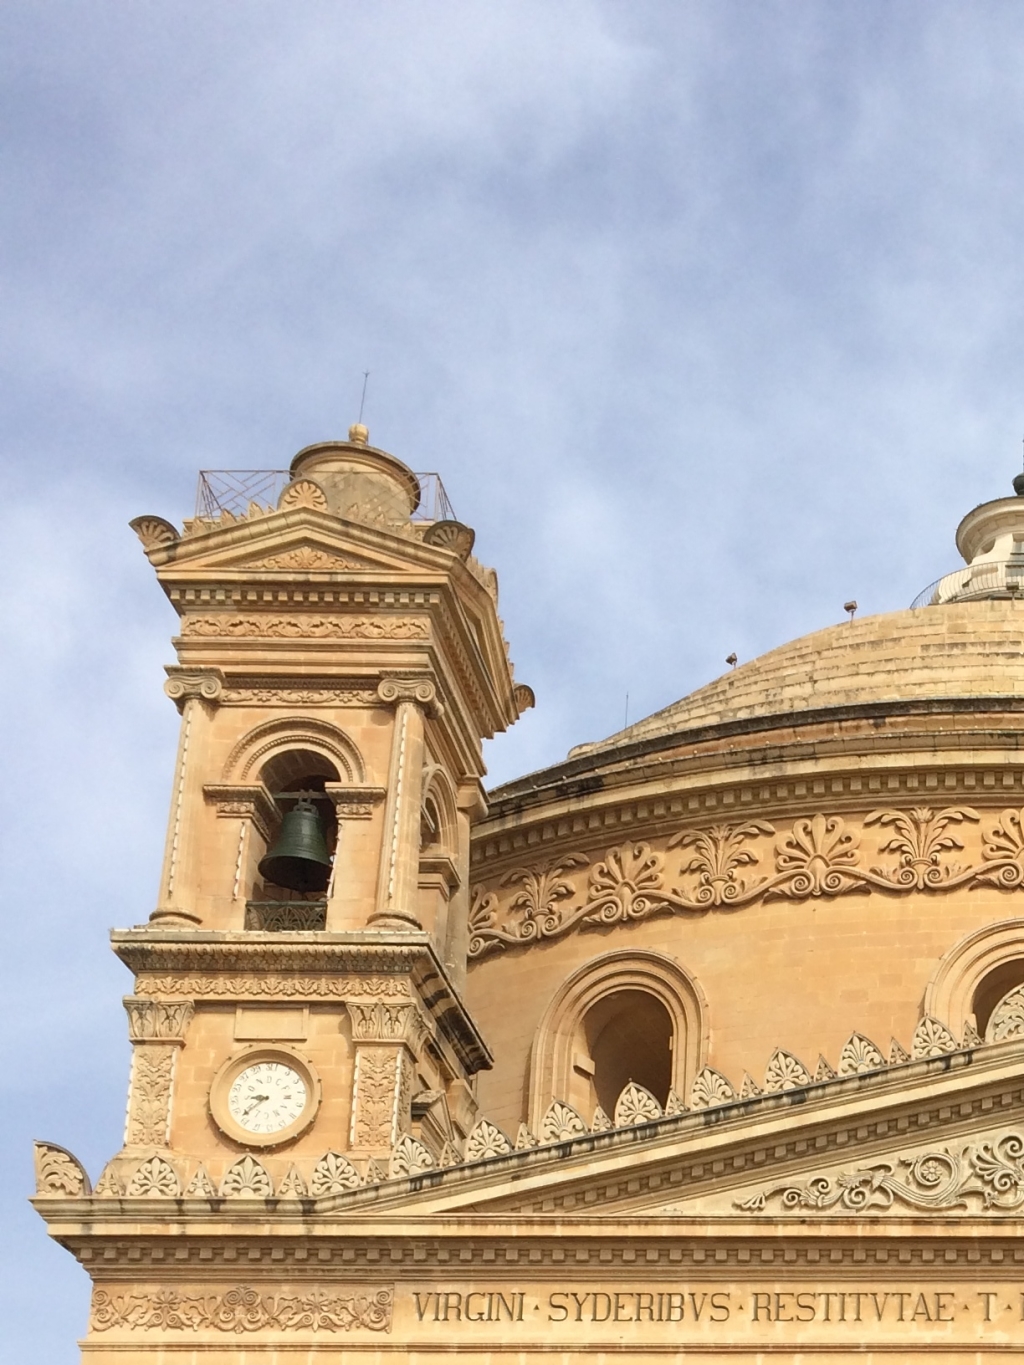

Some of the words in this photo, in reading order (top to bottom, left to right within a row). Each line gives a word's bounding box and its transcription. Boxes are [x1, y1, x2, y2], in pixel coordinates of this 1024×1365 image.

[411, 1292, 526, 1323] VIRGINI
[547, 1292, 731, 1323] SYDERIBVS
[751, 1292, 955, 1323] RESTITVTAE
[977, 1292, 998, 1323] T
